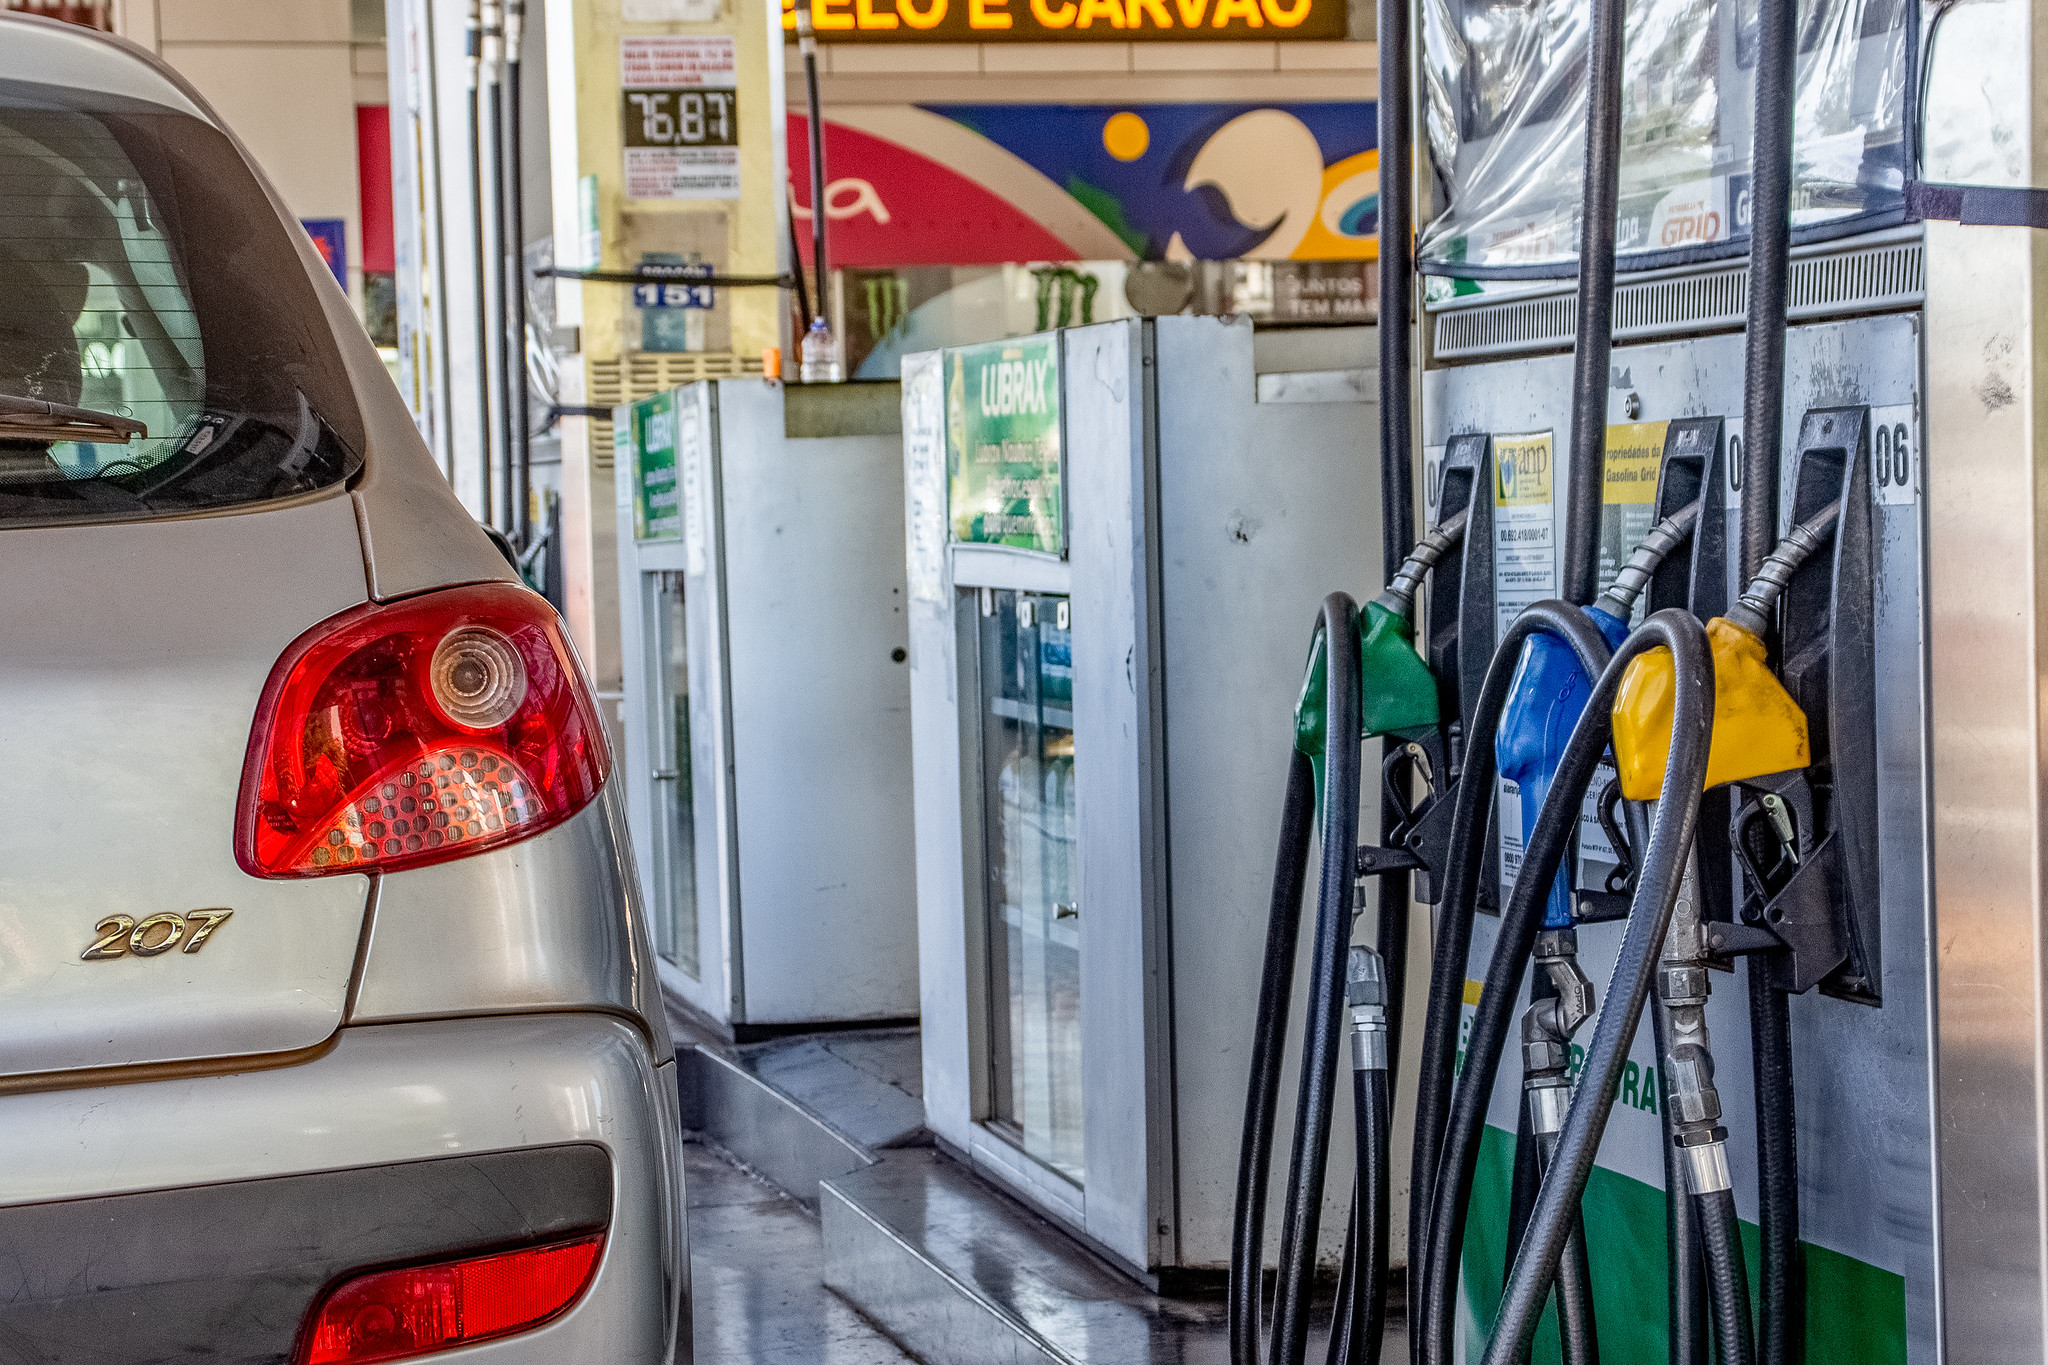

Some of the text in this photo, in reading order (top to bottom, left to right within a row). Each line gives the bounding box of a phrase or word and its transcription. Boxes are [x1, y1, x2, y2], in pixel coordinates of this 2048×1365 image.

[781, 0, 949, 29] ELO
[1661, 211, 1721, 248] GRID
[637, 285, 711, 306] 151
[980, 358, 1049, 417] LUBRAX
[1518, 444, 1547, 486] anp
[1606, 444, 1650, 462] ropriedades
[1729, 433, 1742, 492] 0
[1876, 422, 1910, 488] 06
[1428, 460, 1437, 508] 0
[1606, 468, 1638, 482] Gasolina
[81, 907, 234, 961] 207
